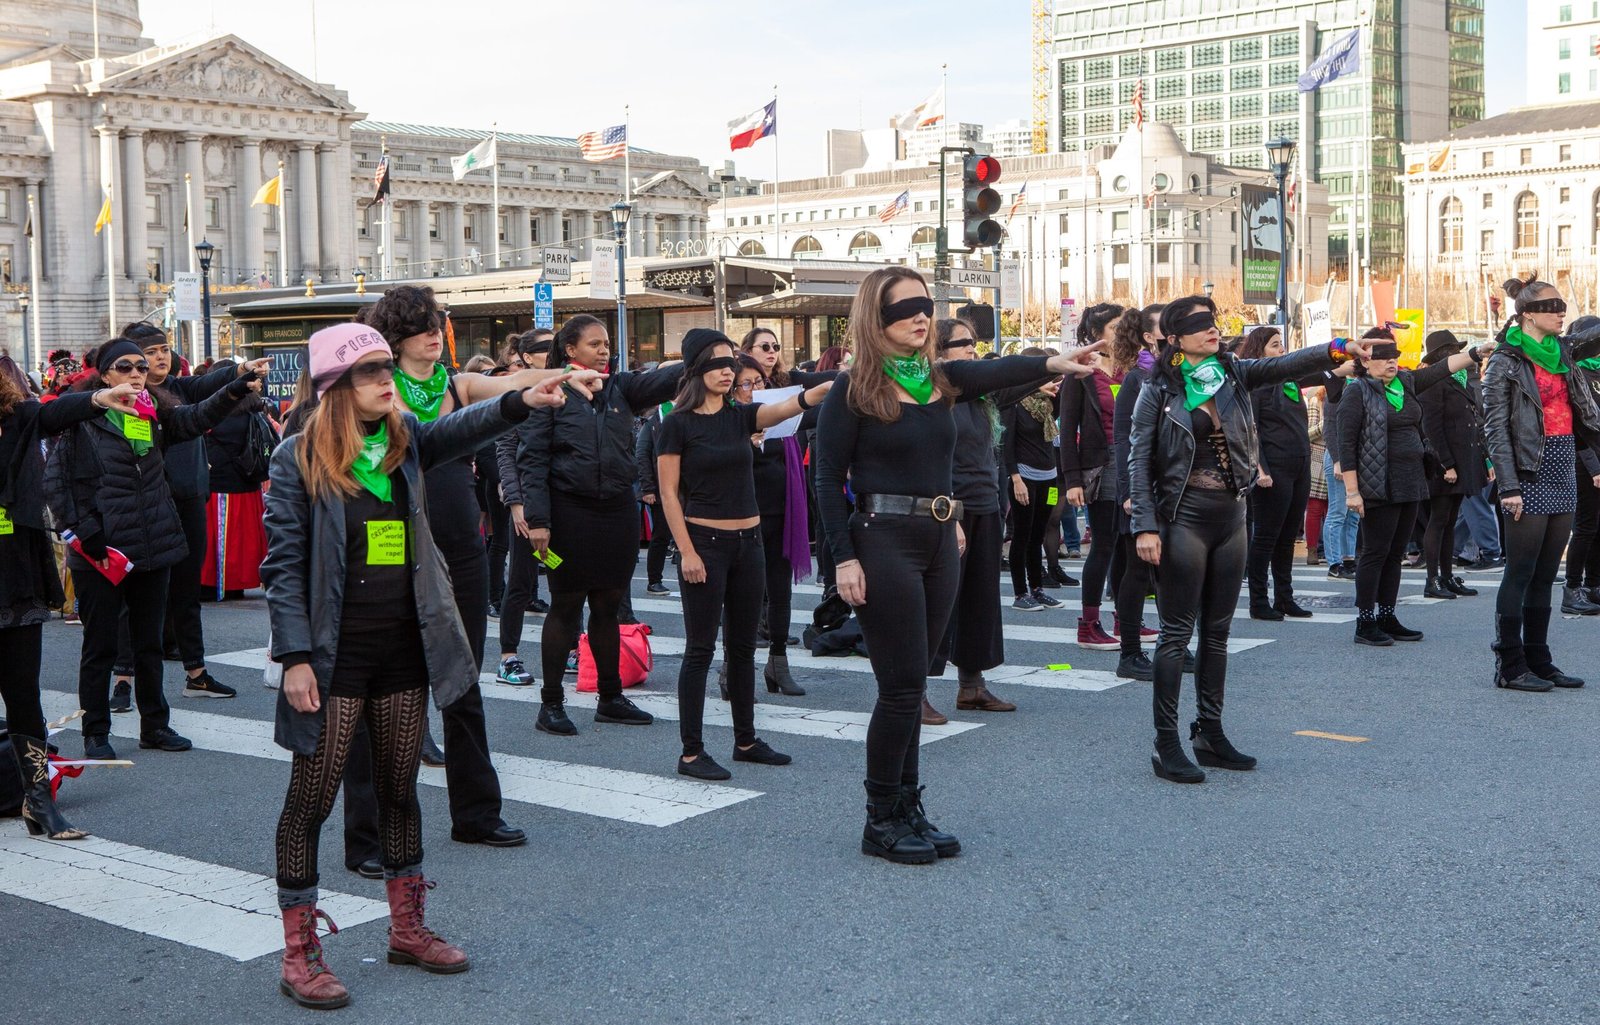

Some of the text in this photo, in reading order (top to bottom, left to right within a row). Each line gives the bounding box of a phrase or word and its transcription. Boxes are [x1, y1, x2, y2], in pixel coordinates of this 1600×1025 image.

[660, 239, 714, 256] 52 GROV
[546, 253, 568, 264] PARK
[546, 267, 569, 276] PARALLEL
[958, 272, 991, 285] LARKIN
[263, 329, 303, 338] SAN FRANCISCO
[267, 353, 304, 371] CIVIC
[267, 384, 298, 397] PIT STO
